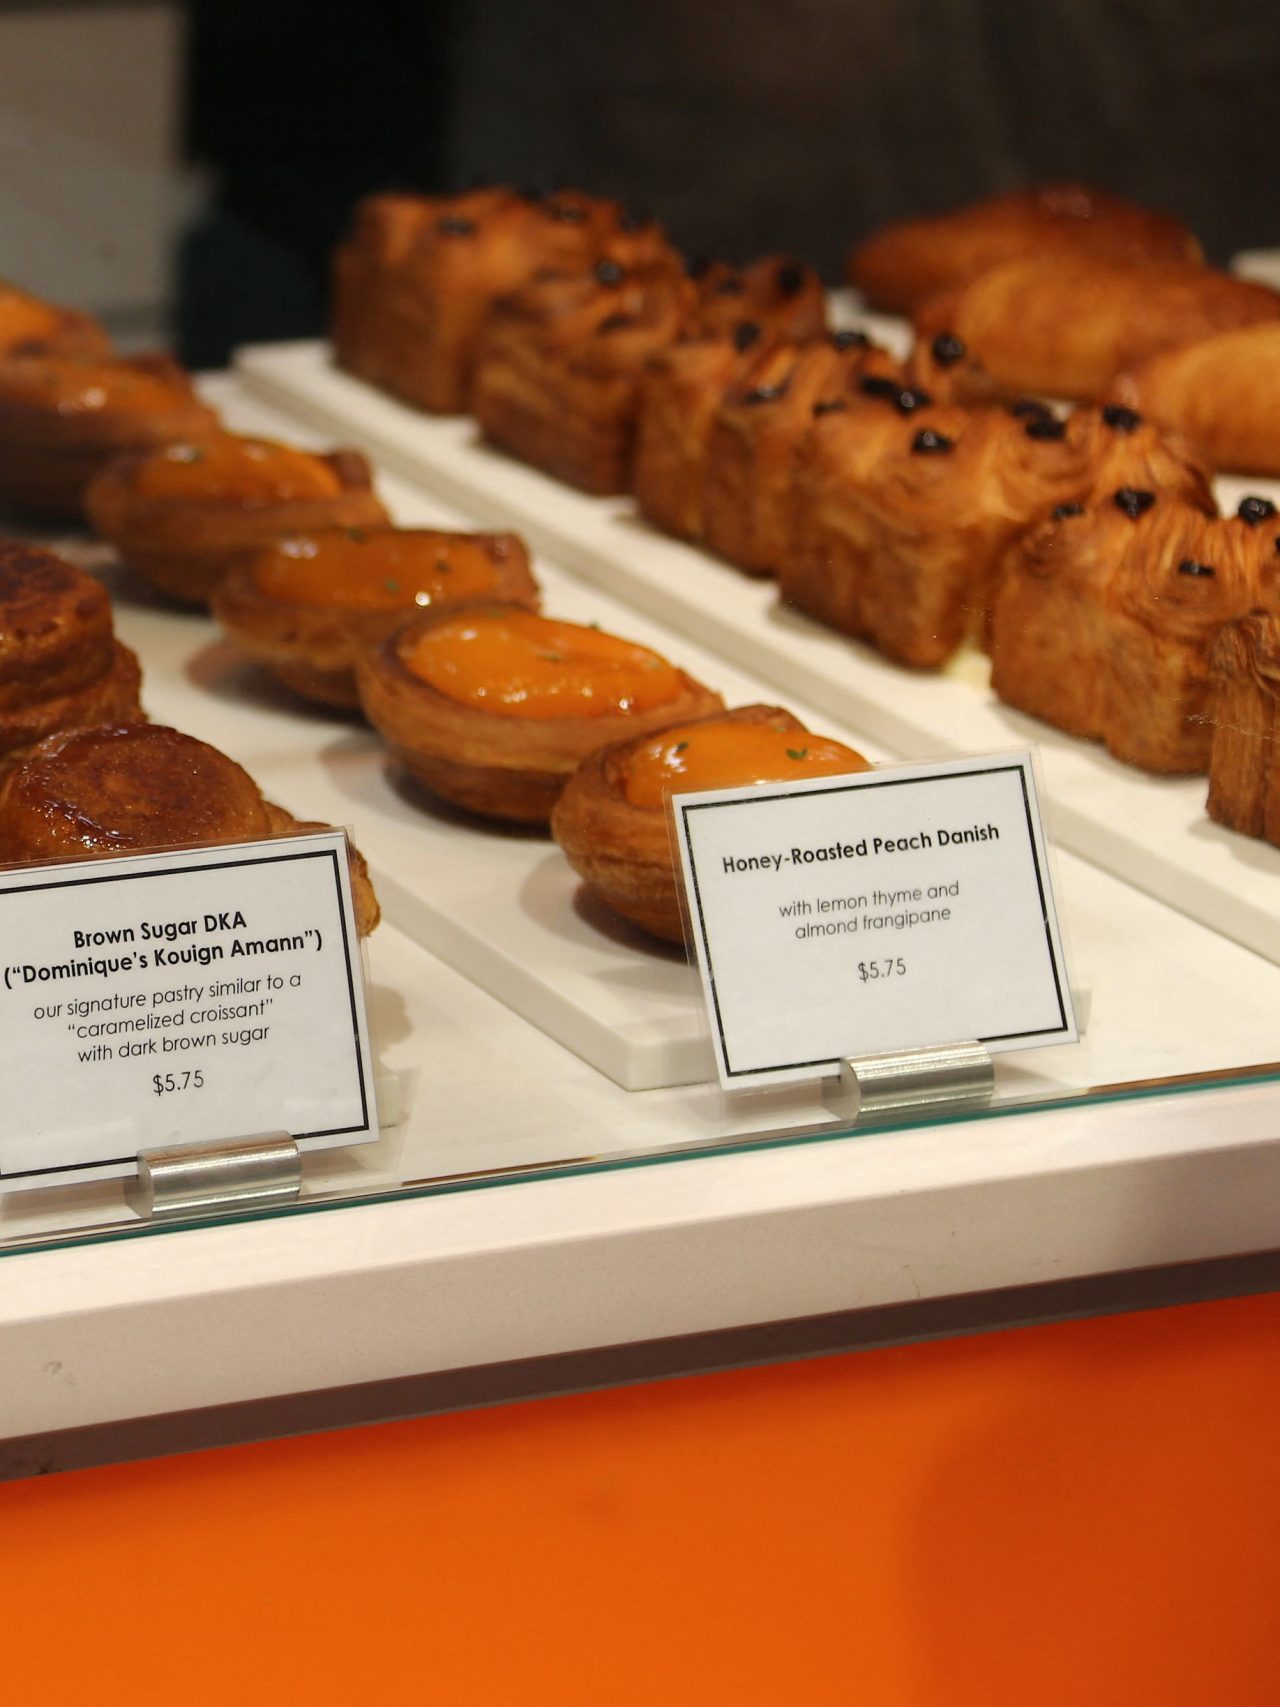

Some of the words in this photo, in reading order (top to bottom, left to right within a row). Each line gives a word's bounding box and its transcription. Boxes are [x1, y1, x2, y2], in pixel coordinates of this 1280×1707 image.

[723, 840, 868, 874] Honey-Roasted
[873, 832, 932, 855] Peach
[937, 823, 999, 846] Danish
[779, 901, 812, 918] with
[817, 894, 867, 914] lemon
[872, 888, 922, 908] thyme
[927, 881, 960, 898] and
[74, 927, 135, 948] Brown
[141, 917, 198, 943] Sugar
[204, 911, 247, 932] DKA
[795, 918, 858, 940] almond
[862, 907, 951, 933] frangipane
[154, 940, 223, 967] Kouign
[858, 958, 907, 983] $5.75
[34, 1004, 62, 1020] our
[67, 991, 147, 1018] signature
[152, 985, 204, 1009] pastry
[209, 978, 262, 997] similar
[267, 975, 284, 990] to
[289, 973, 301, 987] a
[77, 1045, 113, 1062] with
[118, 1039, 157, 1058] dark
[163, 1032, 216, 1052] brown
[222, 1027, 269, 1049] sugar
[153, 1069, 204, 1096] $5.75
